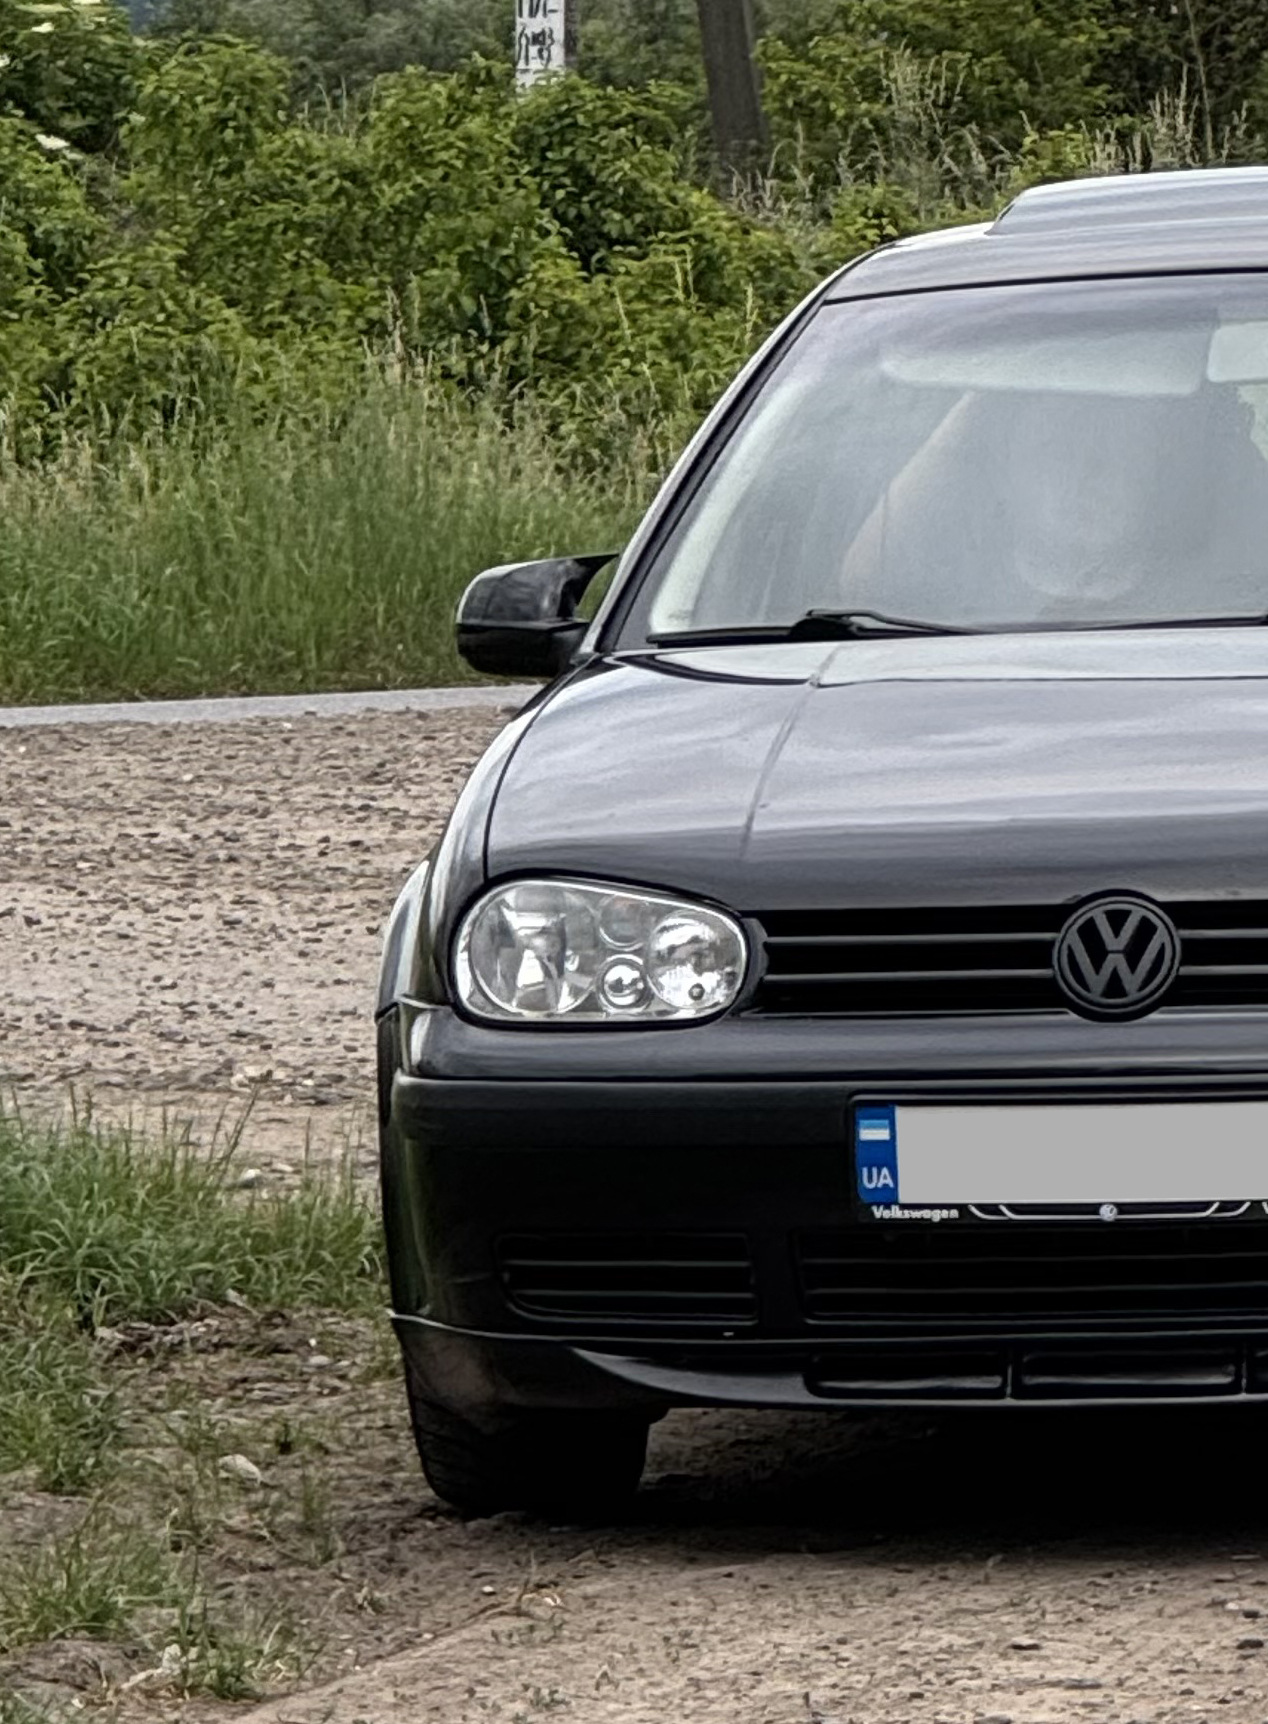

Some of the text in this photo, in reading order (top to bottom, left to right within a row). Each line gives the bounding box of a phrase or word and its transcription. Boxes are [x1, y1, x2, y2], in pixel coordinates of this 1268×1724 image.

[1060, 902, 1173, 1008] VW
[862, 1166, 894, 1189] UA
[871, 1204, 959, 1223] Volkswagen
